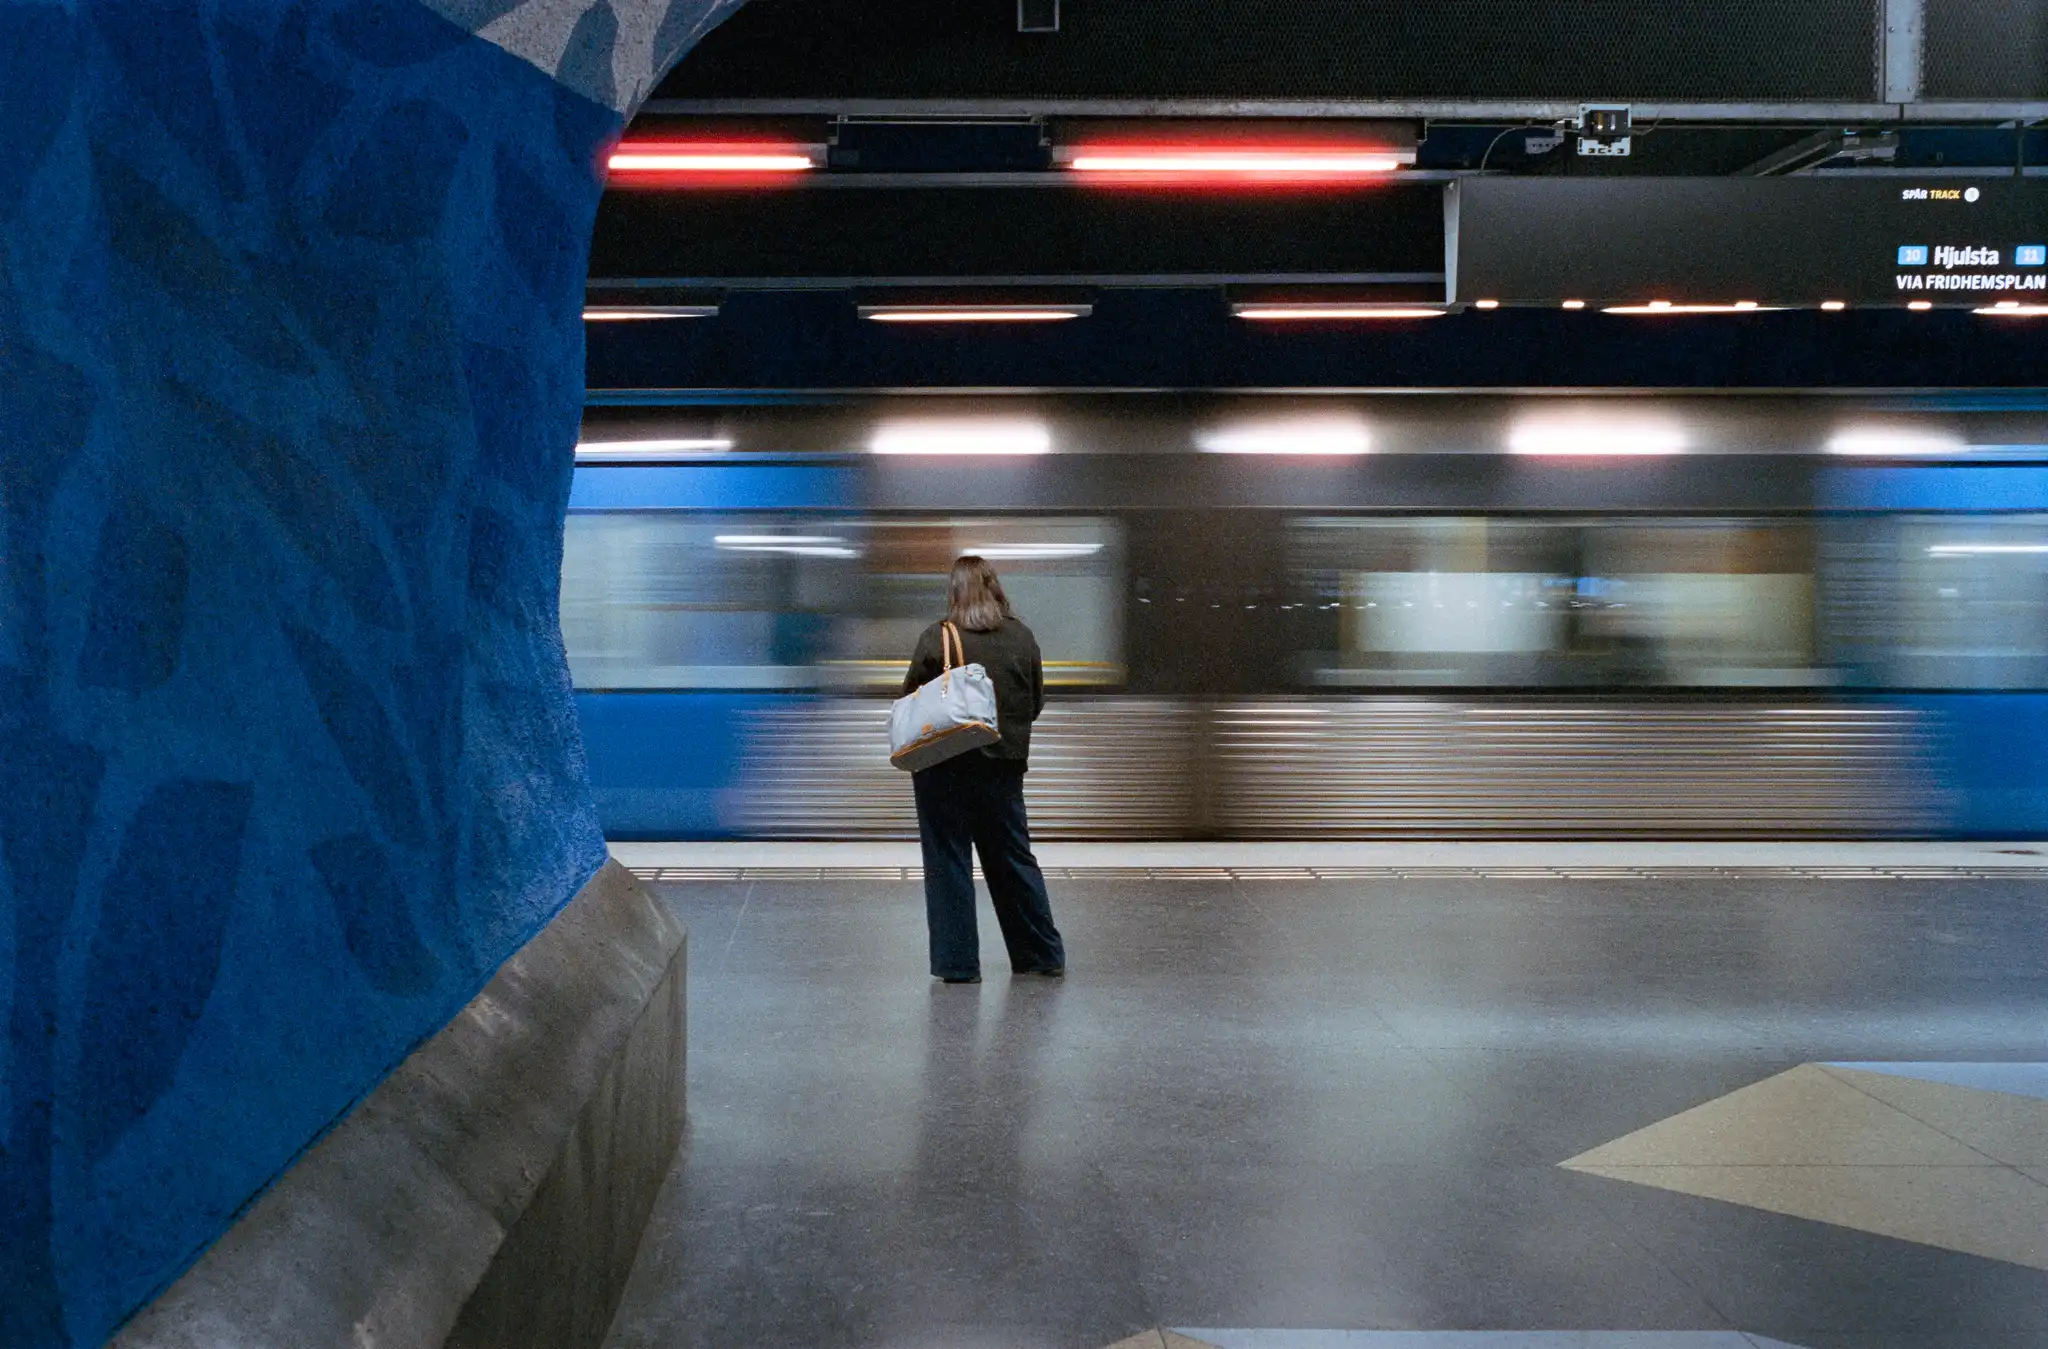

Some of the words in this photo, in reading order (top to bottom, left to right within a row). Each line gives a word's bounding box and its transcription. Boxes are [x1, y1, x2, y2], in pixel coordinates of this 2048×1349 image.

[1902, 188, 1928, 200] SPÅR
[1930, 189, 1960, 200] TRACK
[1905, 249, 1921, 262] 10
[1934, 245, 2000, 269] Hjulsta
[1896, 275, 1923, 289] VIA
[1926, 274, 2046, 290] FRIDHEMSPLAN
